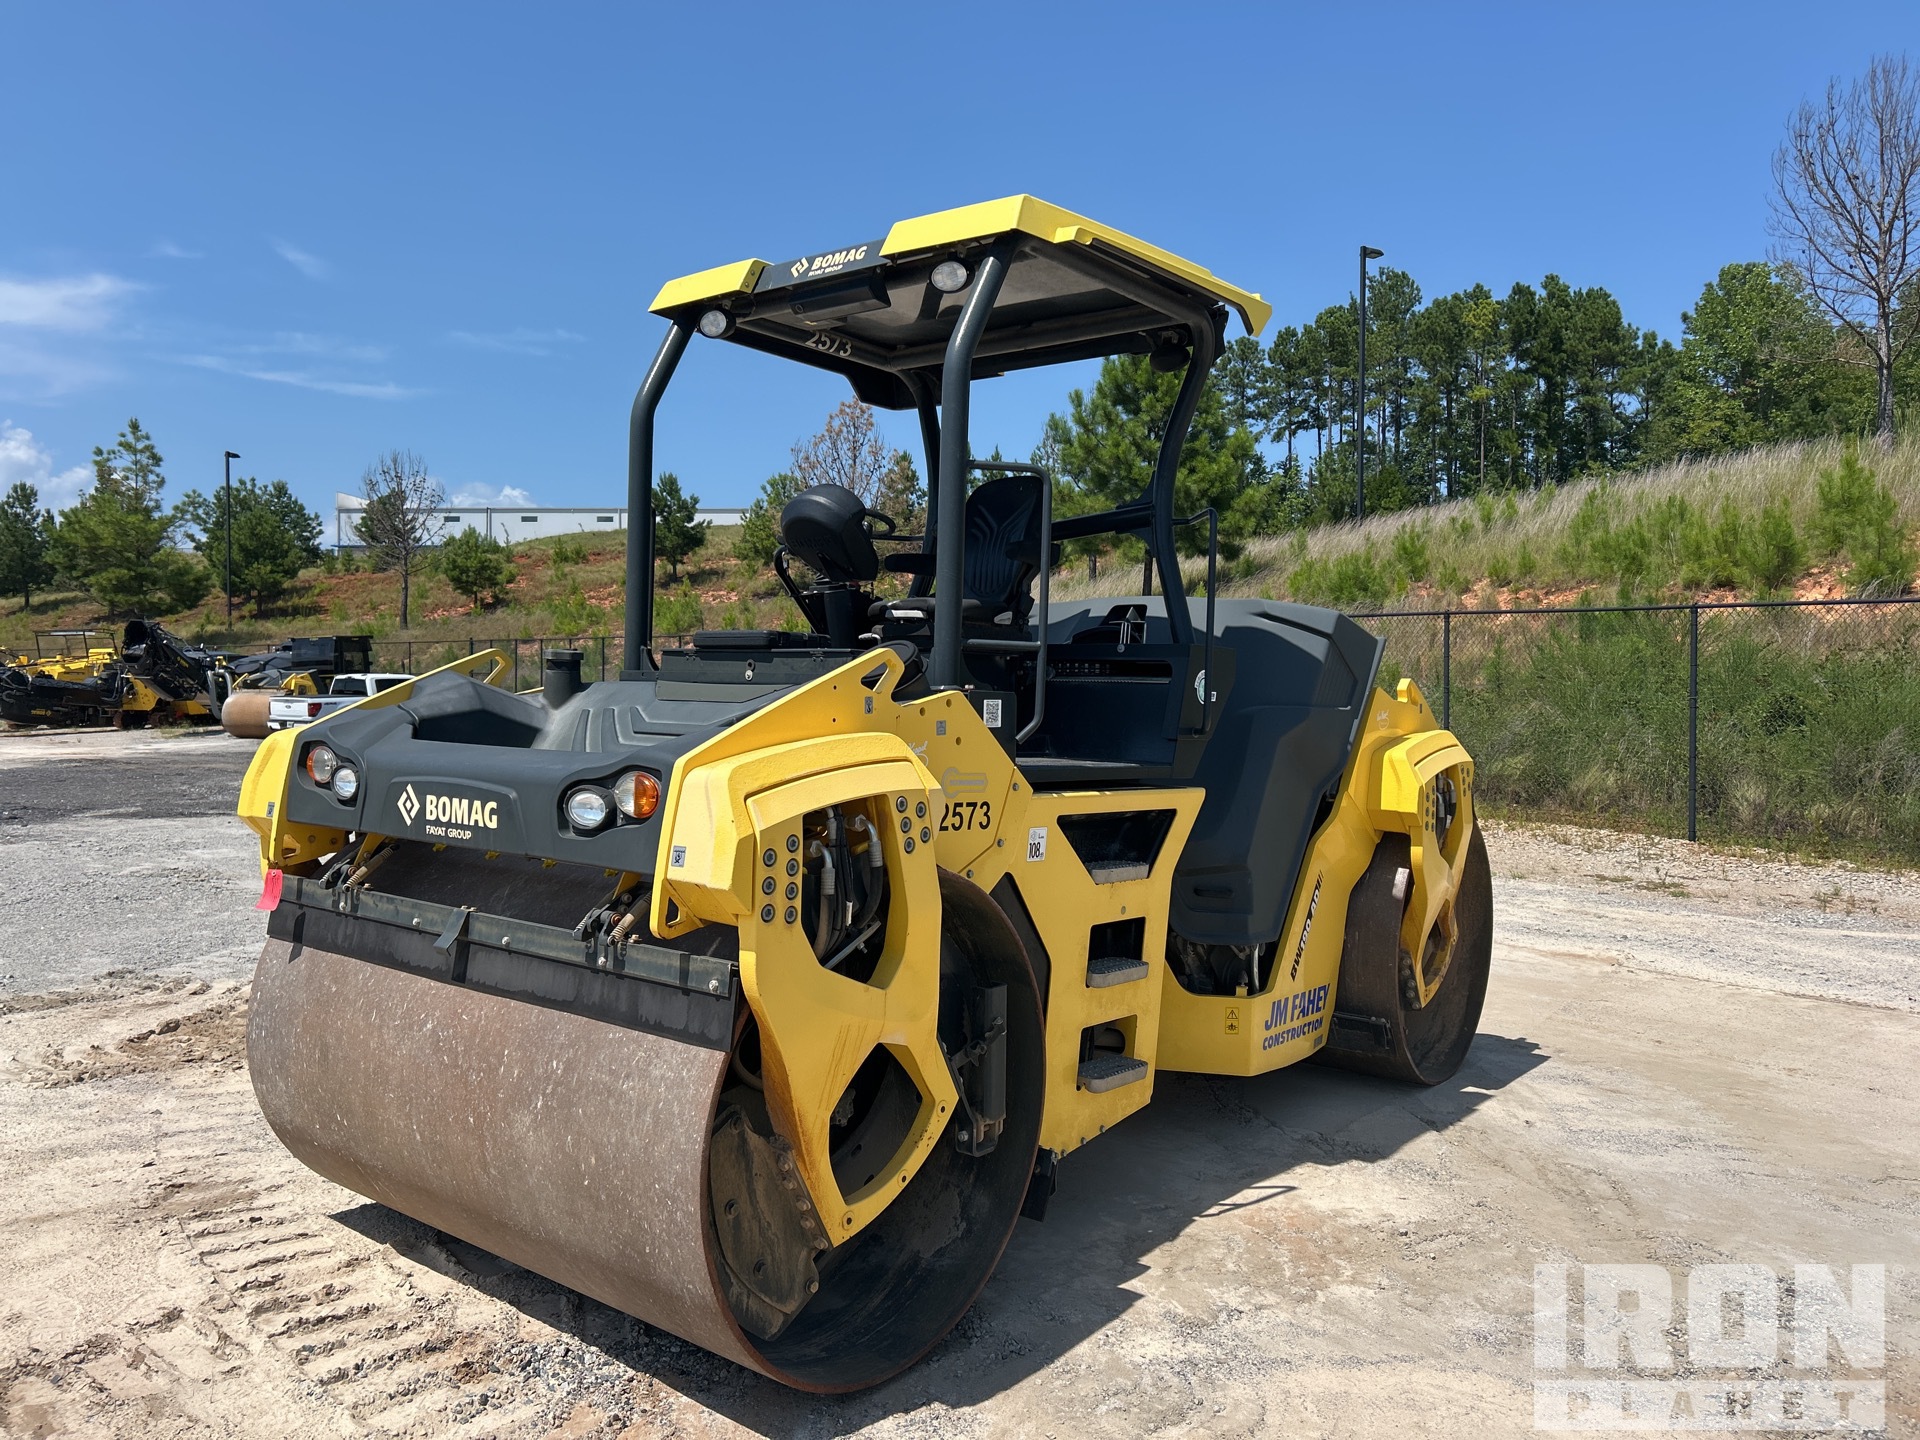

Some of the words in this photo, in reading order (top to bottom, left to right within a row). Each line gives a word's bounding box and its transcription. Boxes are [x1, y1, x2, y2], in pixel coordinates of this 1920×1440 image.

[811, 246, 868, 270] BOMAG
[825, 265, 844, 273] GROUP
[426, 795, 498, 829] BOMAG
[939, 801, 991, 831] 2573
[426, 825, 446, 837] FAYAT
[447, 828, 472, 840] GROUP
[1029, 842, 1041, 859] 108
[1265, 997, 1289, 1031] JM
[1290, 983, 1330, 1023] FAHEY
[1262, 1016, 1324, 1051] CONSTRUCTION
